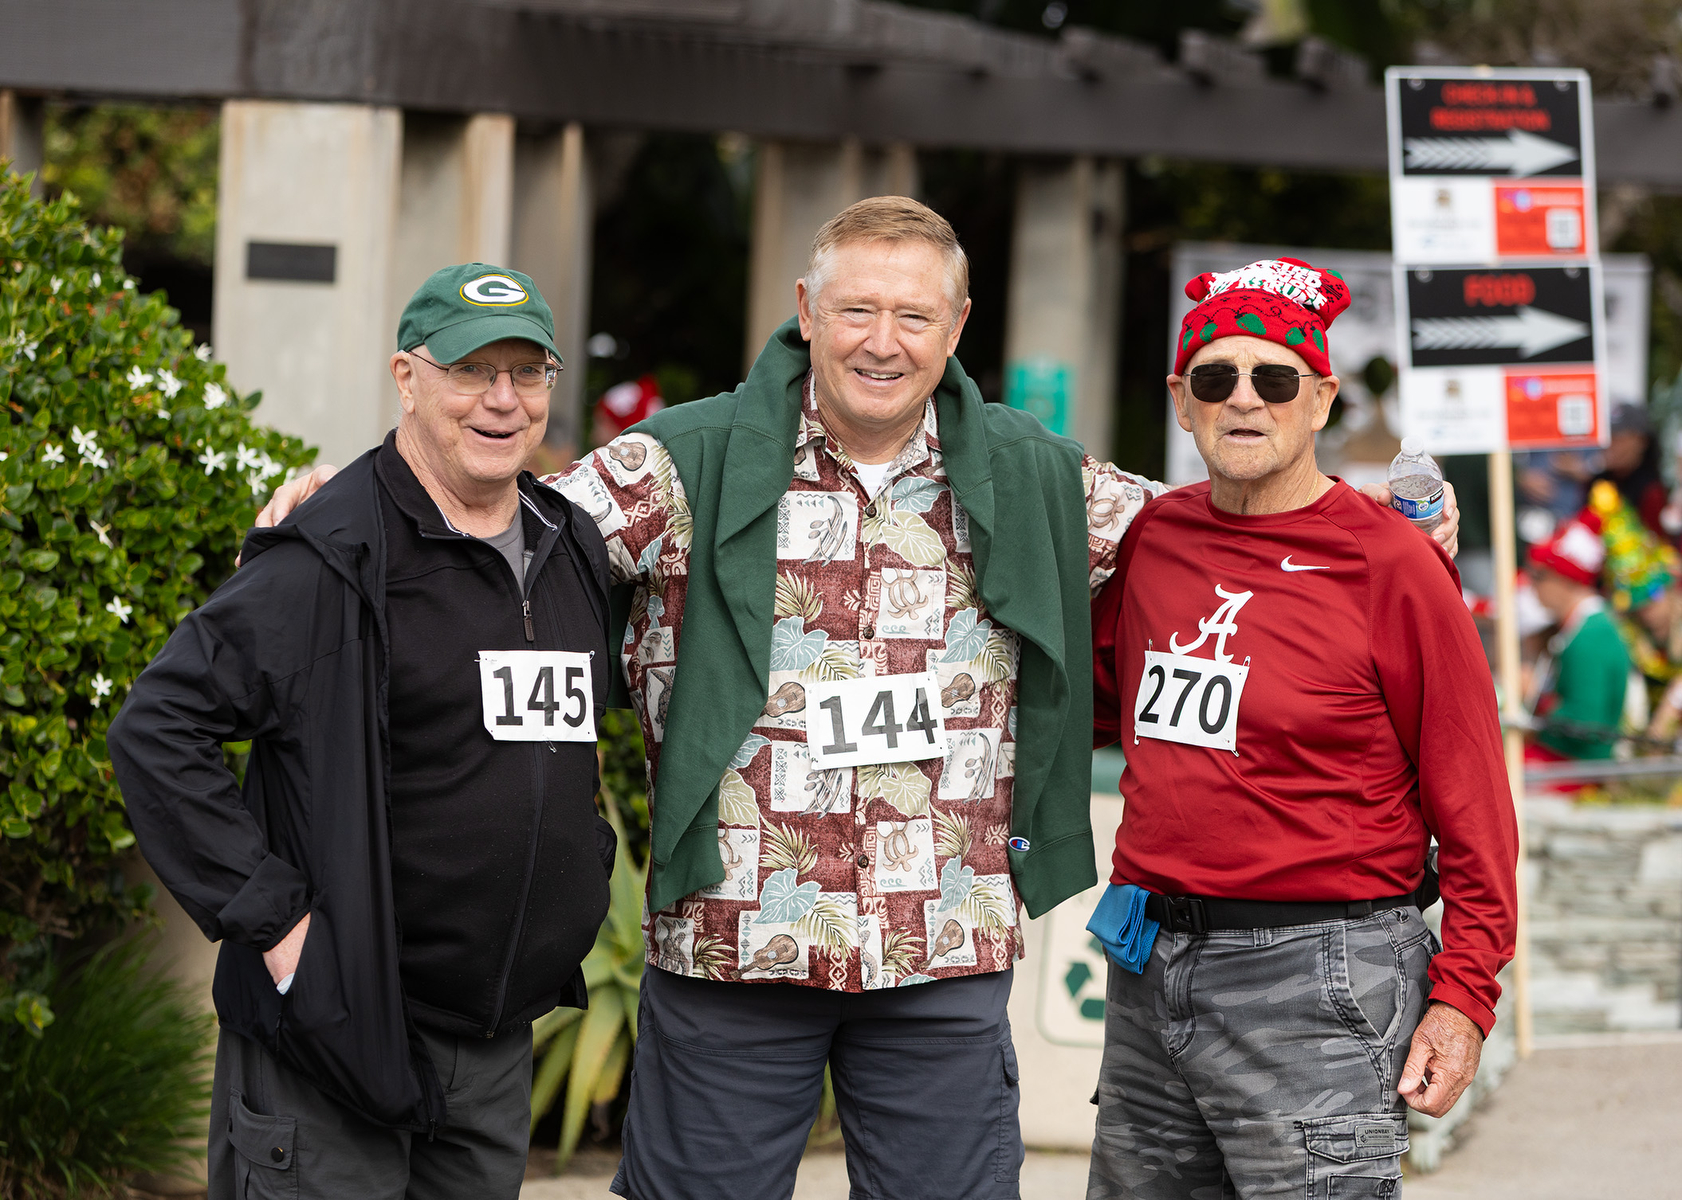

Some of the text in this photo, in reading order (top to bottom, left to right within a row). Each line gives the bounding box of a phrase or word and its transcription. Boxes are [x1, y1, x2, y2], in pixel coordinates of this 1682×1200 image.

[461, 274, 527, 305] G
[1463, 274, 1536, 306] FOOD
[1169, 584, 1254, 663] A
[493, 666, 586, 728] 145
[820, 687, 938, 755] 144
[1139, 665, 1232, 734] 270
